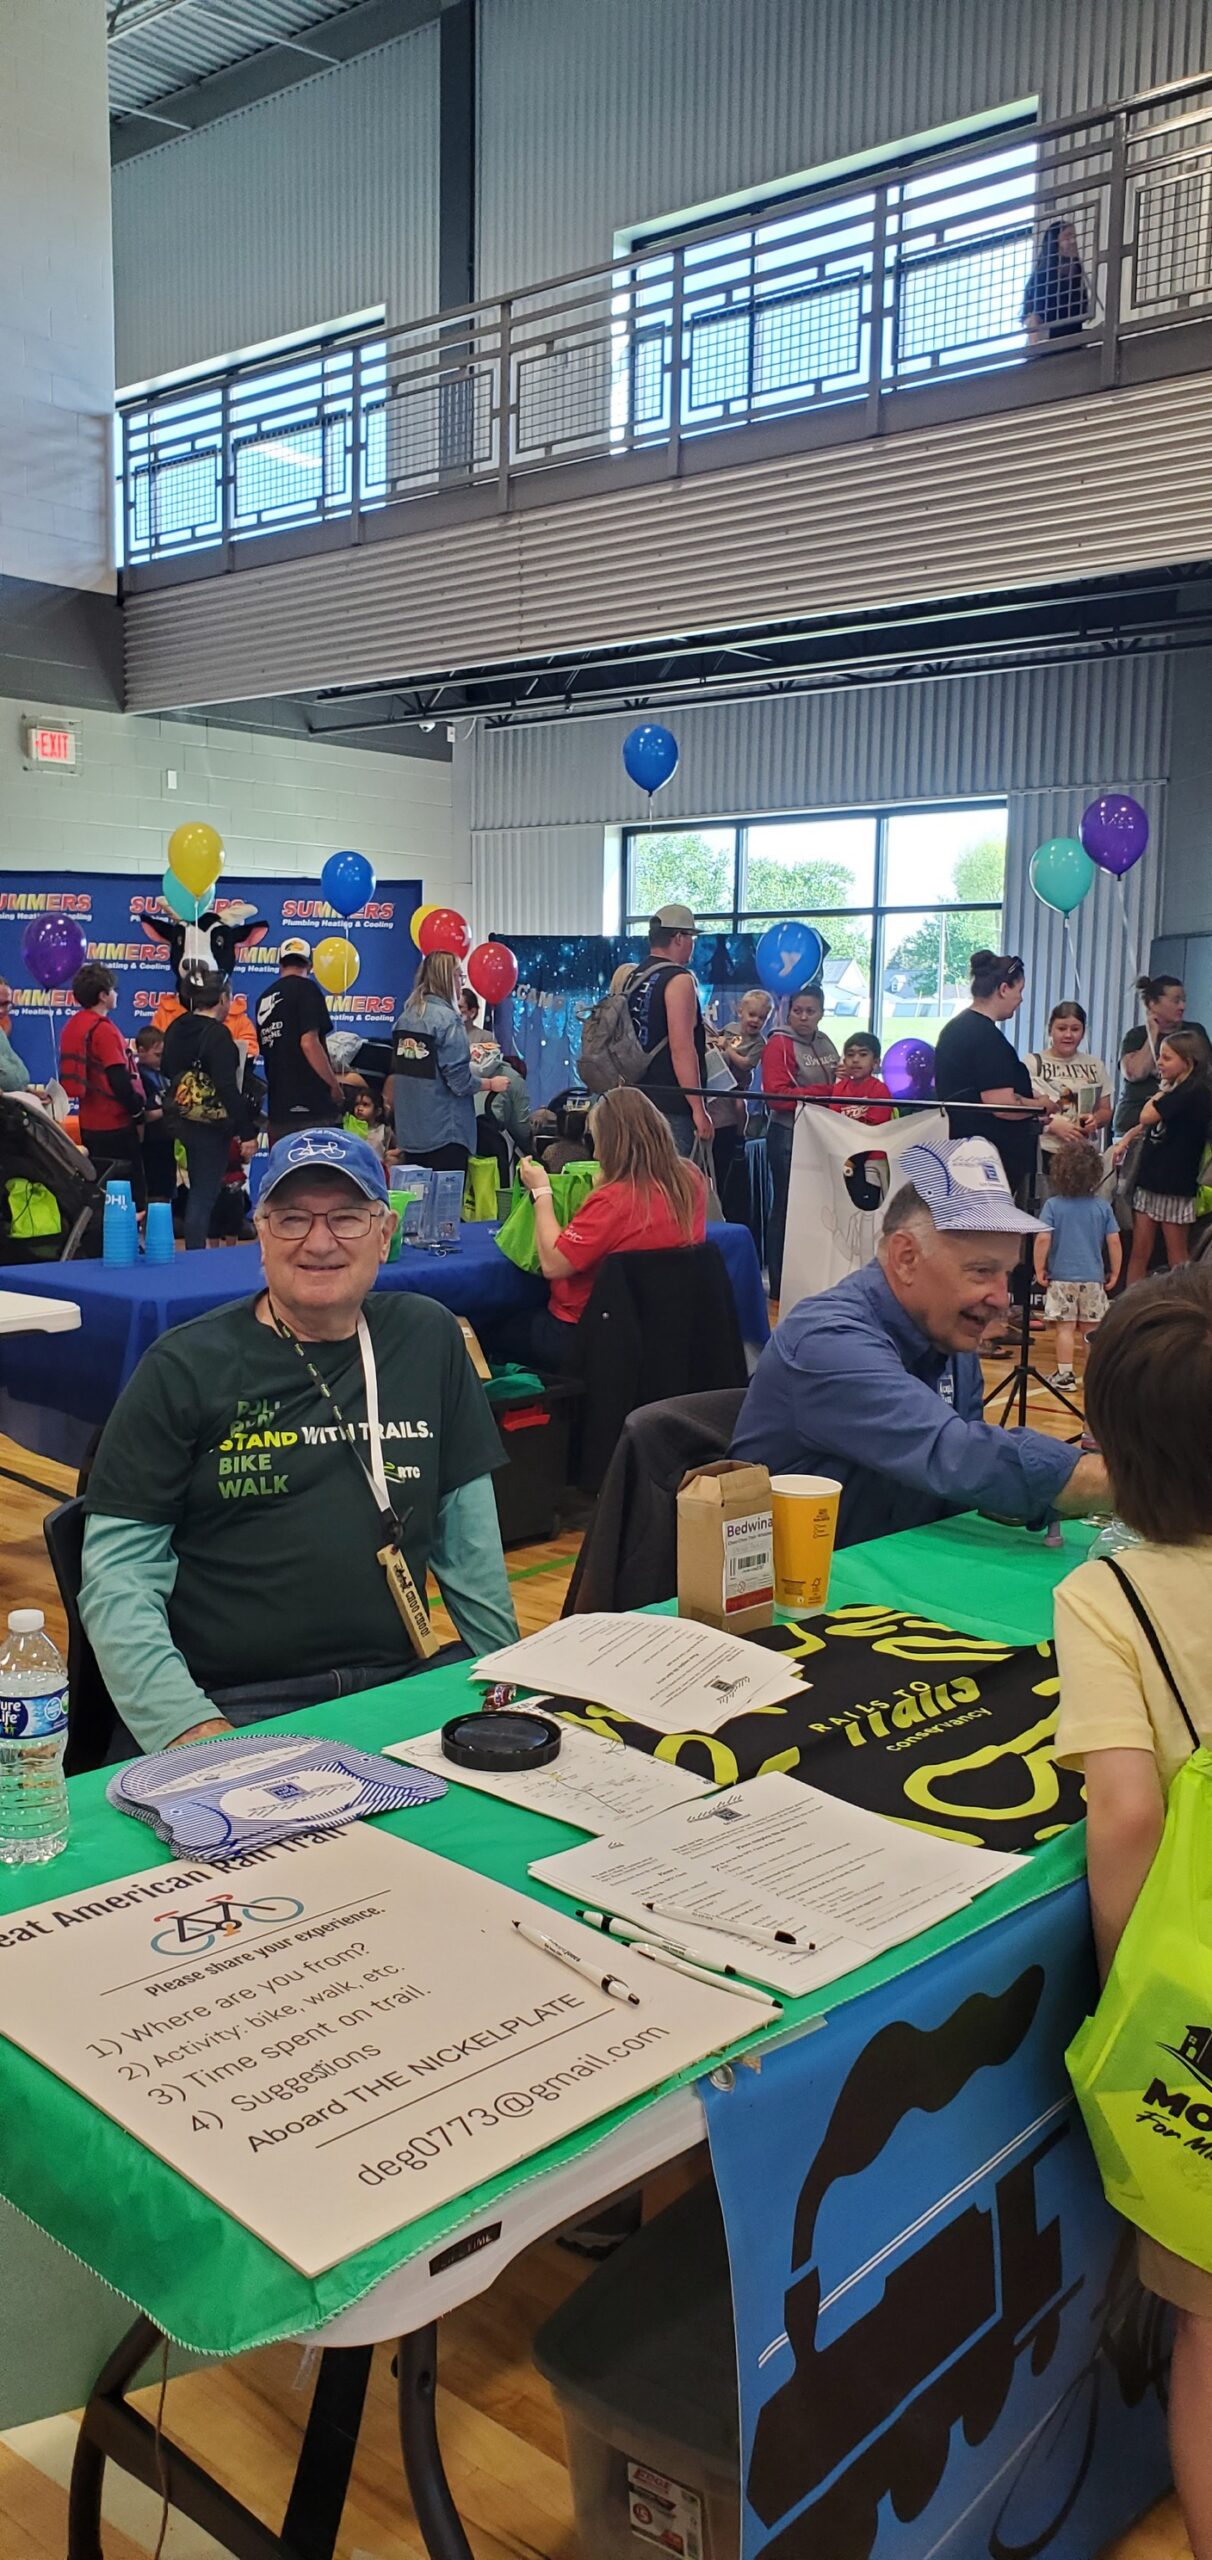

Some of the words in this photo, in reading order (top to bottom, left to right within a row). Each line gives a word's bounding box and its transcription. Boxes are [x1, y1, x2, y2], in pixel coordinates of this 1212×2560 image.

[41, 732, 69, 759] EXIT
[282, 919, 320, 928] Plumbing
[321, 919, 352, 928] Heating
[364, 921, 394, 929] Cooling
[87, 942, 171, 961] MMERS
[139, 962, 171, 971] Cooling
[247, 965, 281, 975] Heating
[325, 995, 395, 1014] MMERS
[330, 1014, 354, 1024] eating
[365, 1014, 395, 1024] Cooling
[220, 1431, 298, 1451] STAND
[219, 1453, 272, 1475] BIKE
[398, 1466, 420, 1478] RTC
[218, 1475, 289, 1499] WALK
[0, 1701, 22, 1712] ure
[0, 1711, 18, 1726] ife
[808, 1700, 891, 1734] RAILS
[893, 1681, 931, 1699] TO
[886, 1707, 993, 1752] conservancy
[0, 1919, 54, 1949] eat
[52, 1867, 213, 1928] American
[144, 1970, 205, 1997] Please
[204, 1951, 255, 1976] share
[253, 1937, 294, 1959] your
[295, 1908, 386, 1944] experience.
[86, 2038, 123, 2060] 1)
[121, 2005, 212, 2043] Where
[215, 1988, 257, 2009] are
[257, 1969, 305, 1995] you
[303, 1942, 370, 1975] from?
[117, 2062, 150, 2082] 2)
[152, 2025, 248, 2068] Activity:
[245, 2003, 306, 2028] bike,
[302, 1978, 364, 2006] walk,
[363, 1963, 405, 1984] etc.
[148, 2083, 187, 2105] 3)
[183, 2056, 258, 2089] Time
[261, 2022, 337, 2059] spent
[338, 2007, 374, 2027] on
[371, 1984, 432, 2012] trail.
[247, 2099, 348, 2153] Aboard
[344, 2071, 411, 2108] THE
[408, 1993, 586, 2077] NICKELPLATE
[191, 2110, 224, 2133] 4)
[231, 2043, 382, 2112] Suggestions
[357, 2024, 671, 2188] deg0773@gmail.com
[1142, 2077, 1212, 2131] MO
[1136, 2111, 1182, 2139] For
